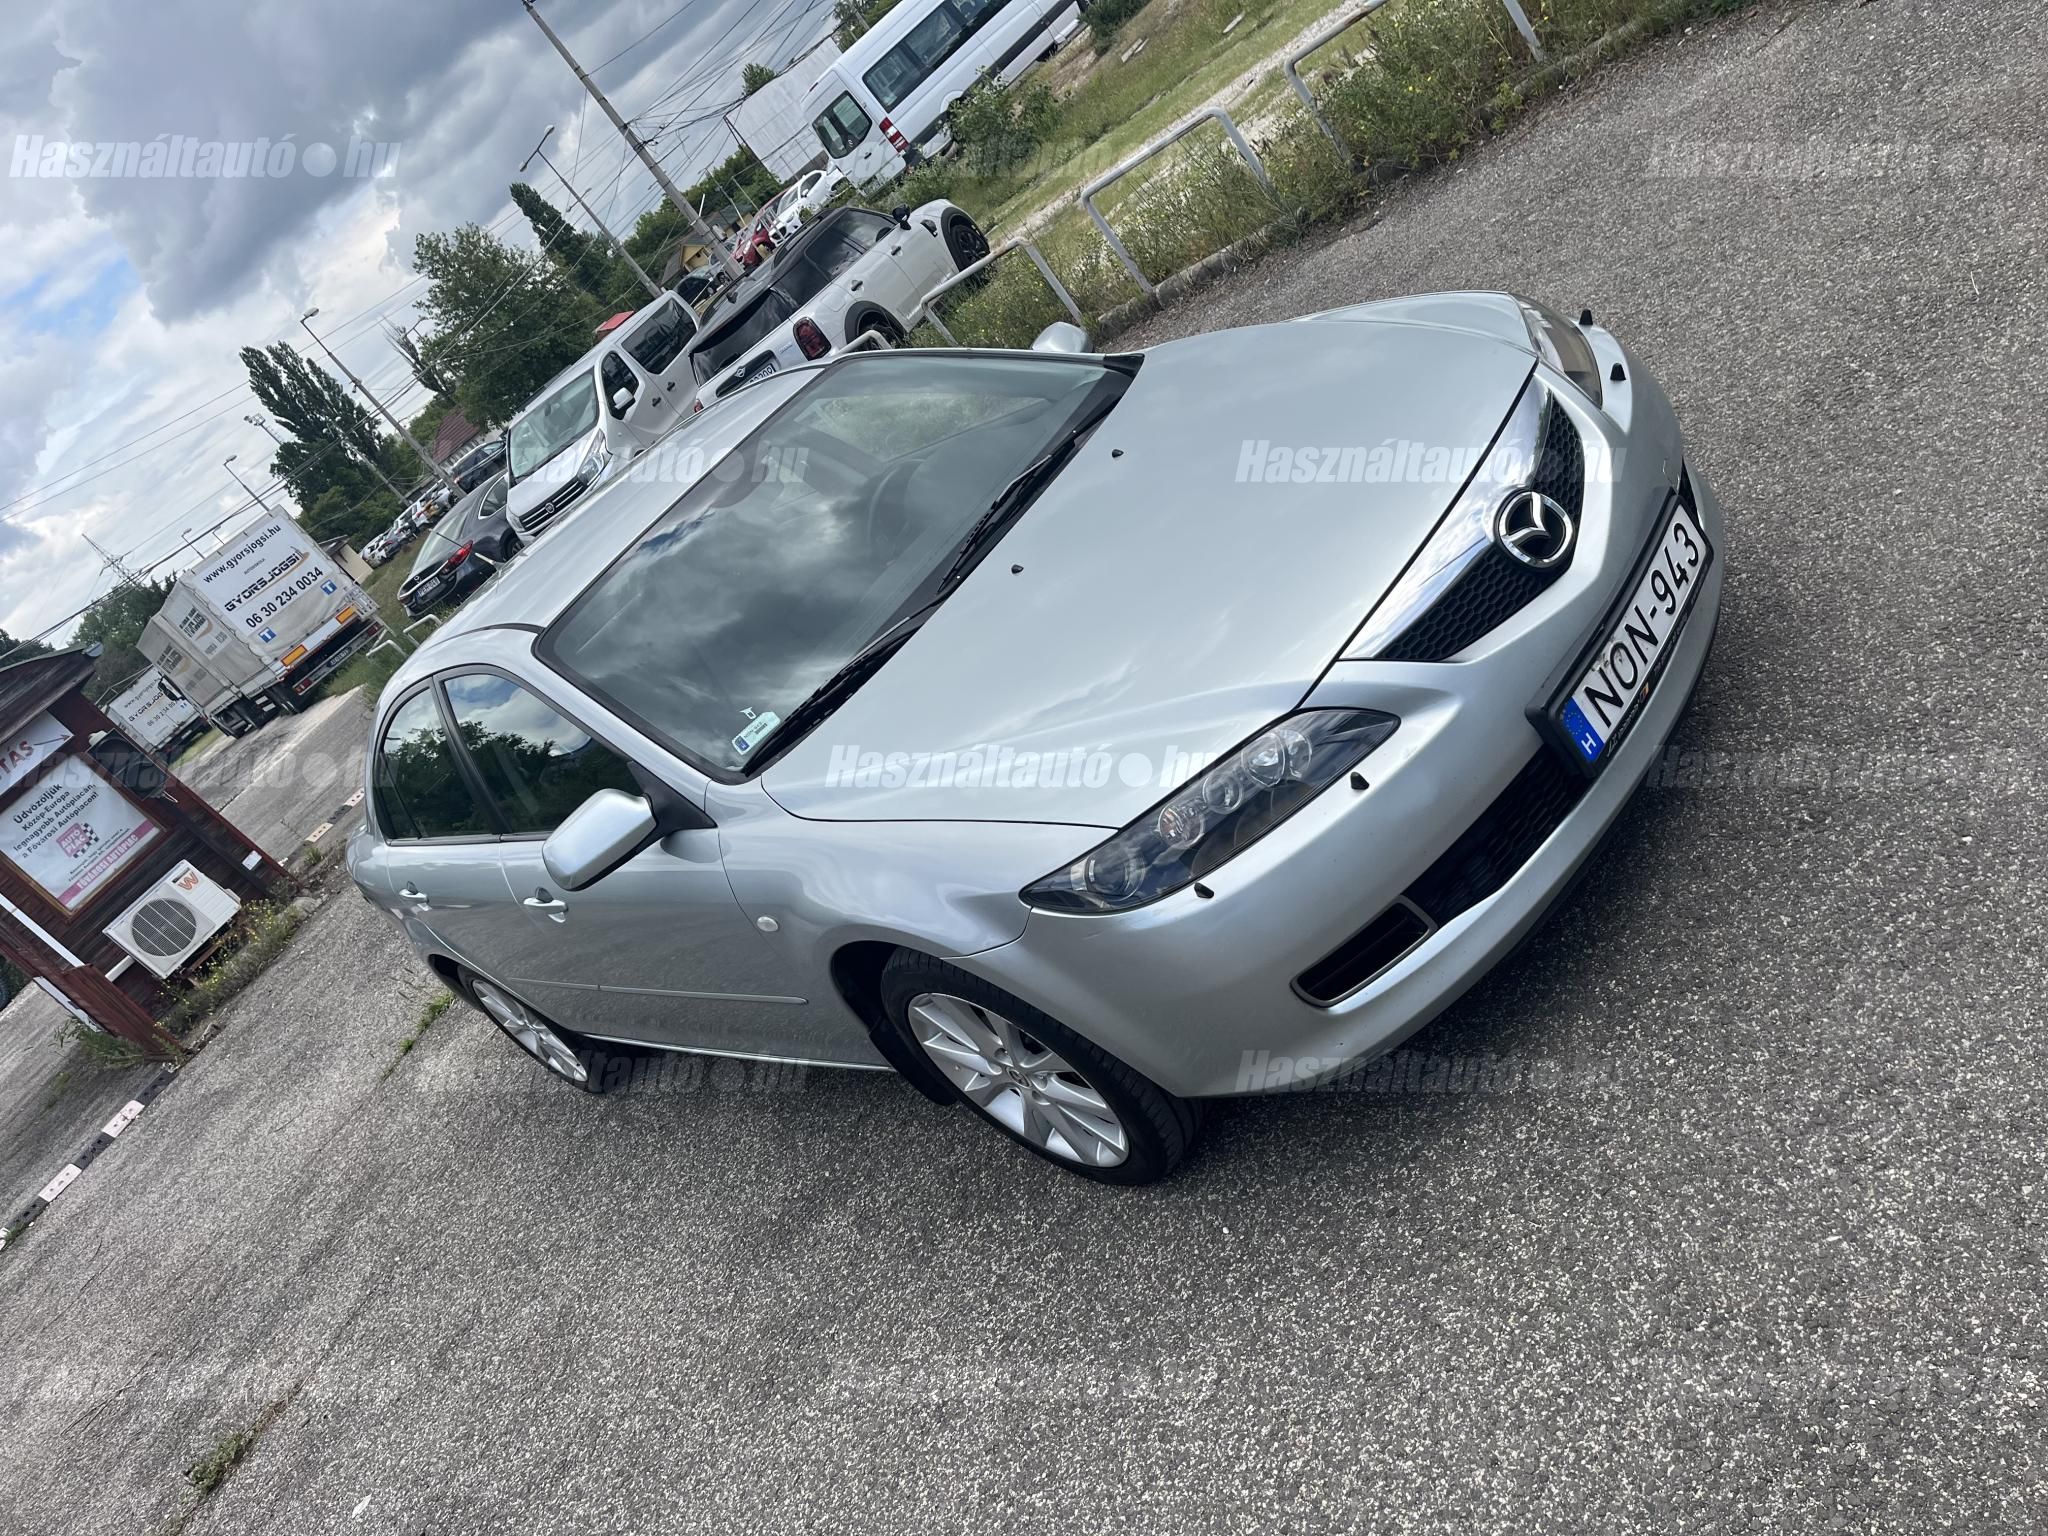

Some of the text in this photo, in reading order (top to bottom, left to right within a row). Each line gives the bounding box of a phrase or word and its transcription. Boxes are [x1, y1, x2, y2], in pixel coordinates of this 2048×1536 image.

[203, 525, 281, 583] www.gyorsjogsi.hu
[246, 566, 323, 628] 06 30 234 0034
[1584, 522, 1699, 728] NON-943
[0, 740, 34, 780] TÁS
[1581, 732, 1597, 754] H
[13, 816, 55, 851] legnagyobb
